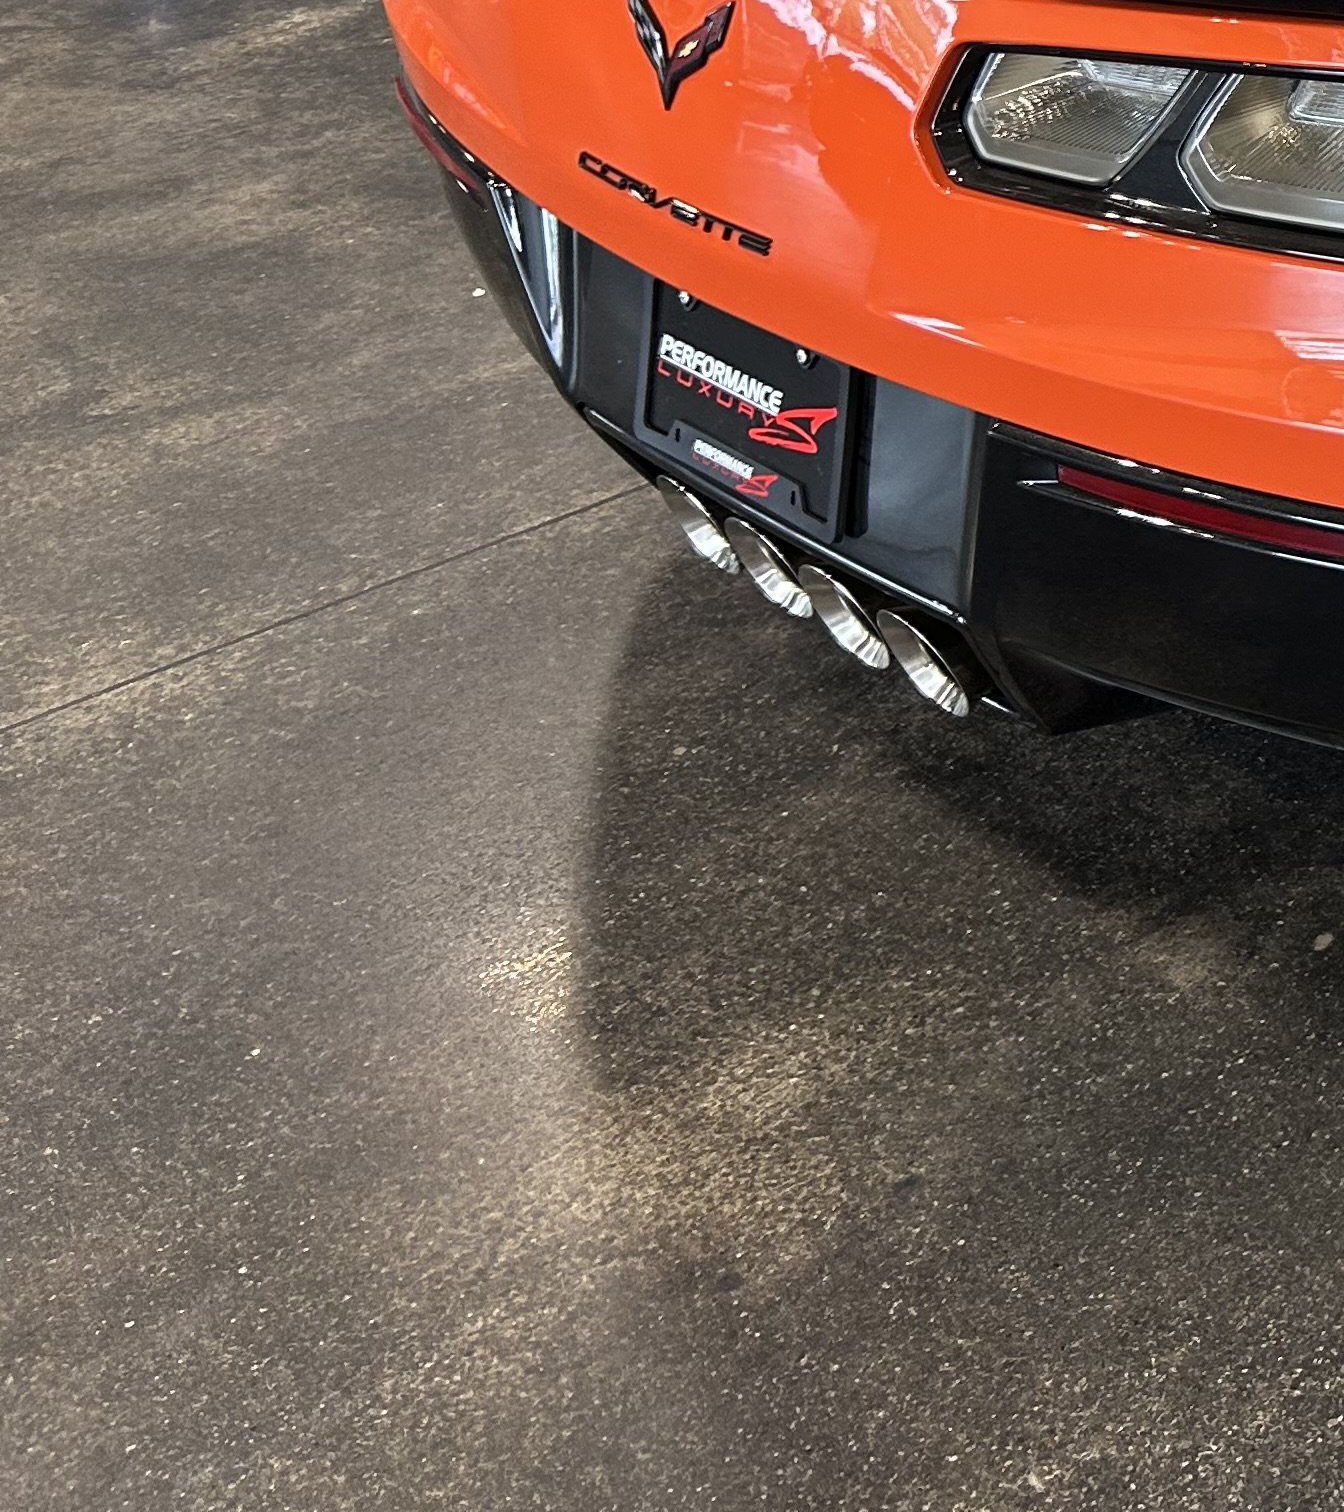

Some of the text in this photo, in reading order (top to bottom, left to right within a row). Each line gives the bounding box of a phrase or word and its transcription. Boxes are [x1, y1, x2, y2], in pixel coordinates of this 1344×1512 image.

[577, 150, 774, 257] CORVETTE
[657, 359, 778, 428] LUXURY
[660, 332, 785, 413] PERFORMANCE
